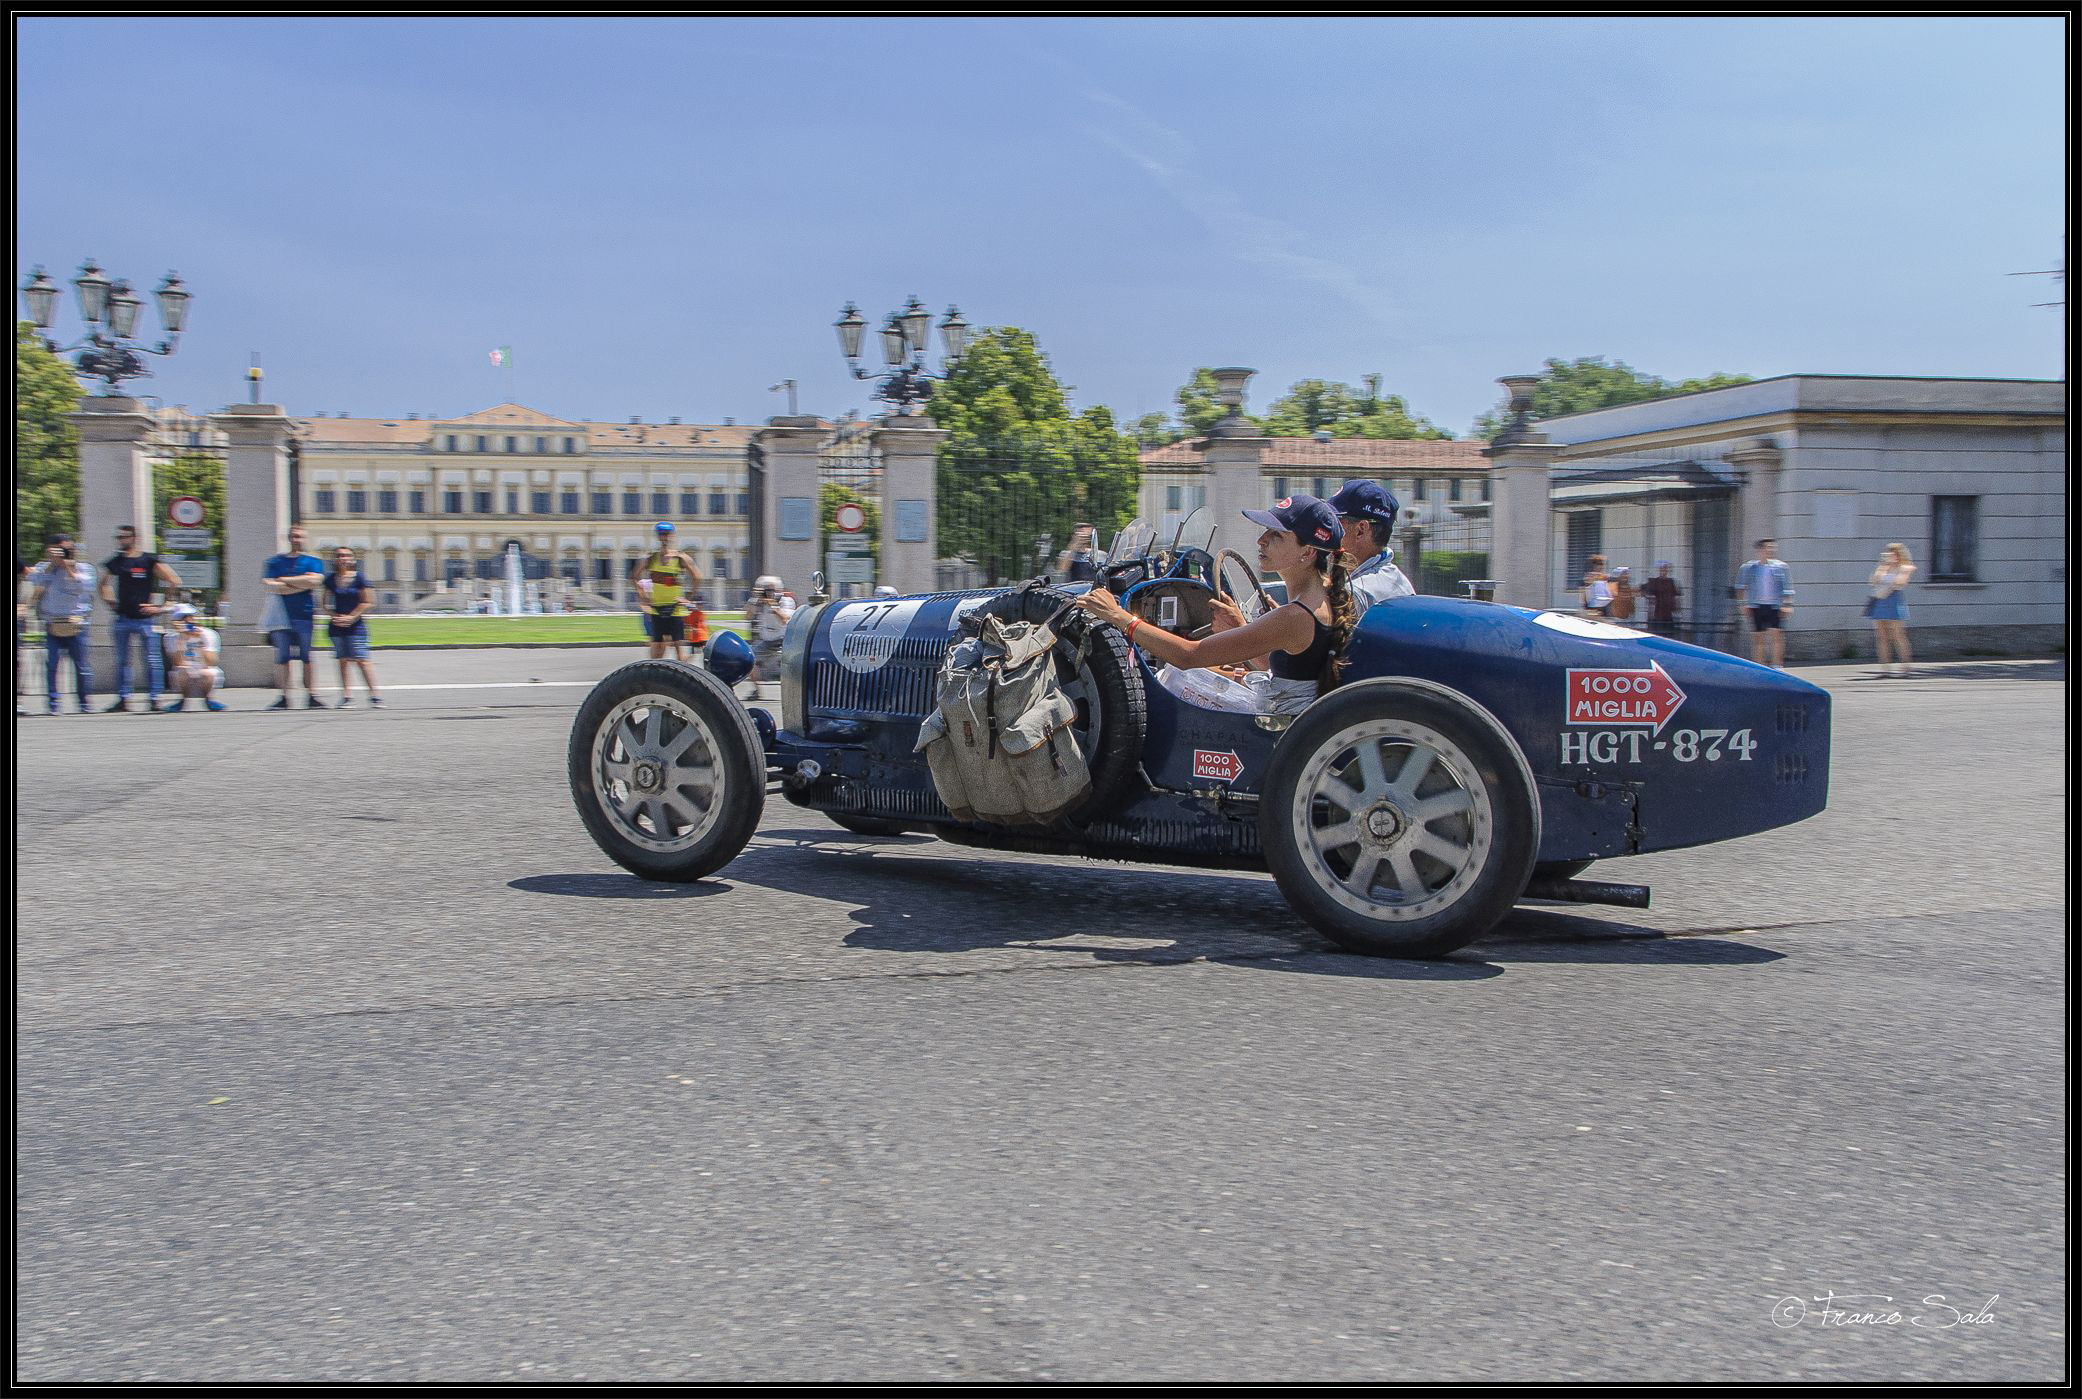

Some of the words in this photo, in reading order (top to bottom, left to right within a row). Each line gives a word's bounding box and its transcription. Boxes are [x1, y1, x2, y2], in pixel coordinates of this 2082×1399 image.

[853, 604, 899, 632] 27
[1581, 676, 1651, 694] 1000
[1575, 700, 1658, 718] MIGLIA
[1560, 728, 1758, 764] HGT-874
[1200, 754, 1229, 765] 1000
[1198, 766, 1231, 776] MIGLIA
